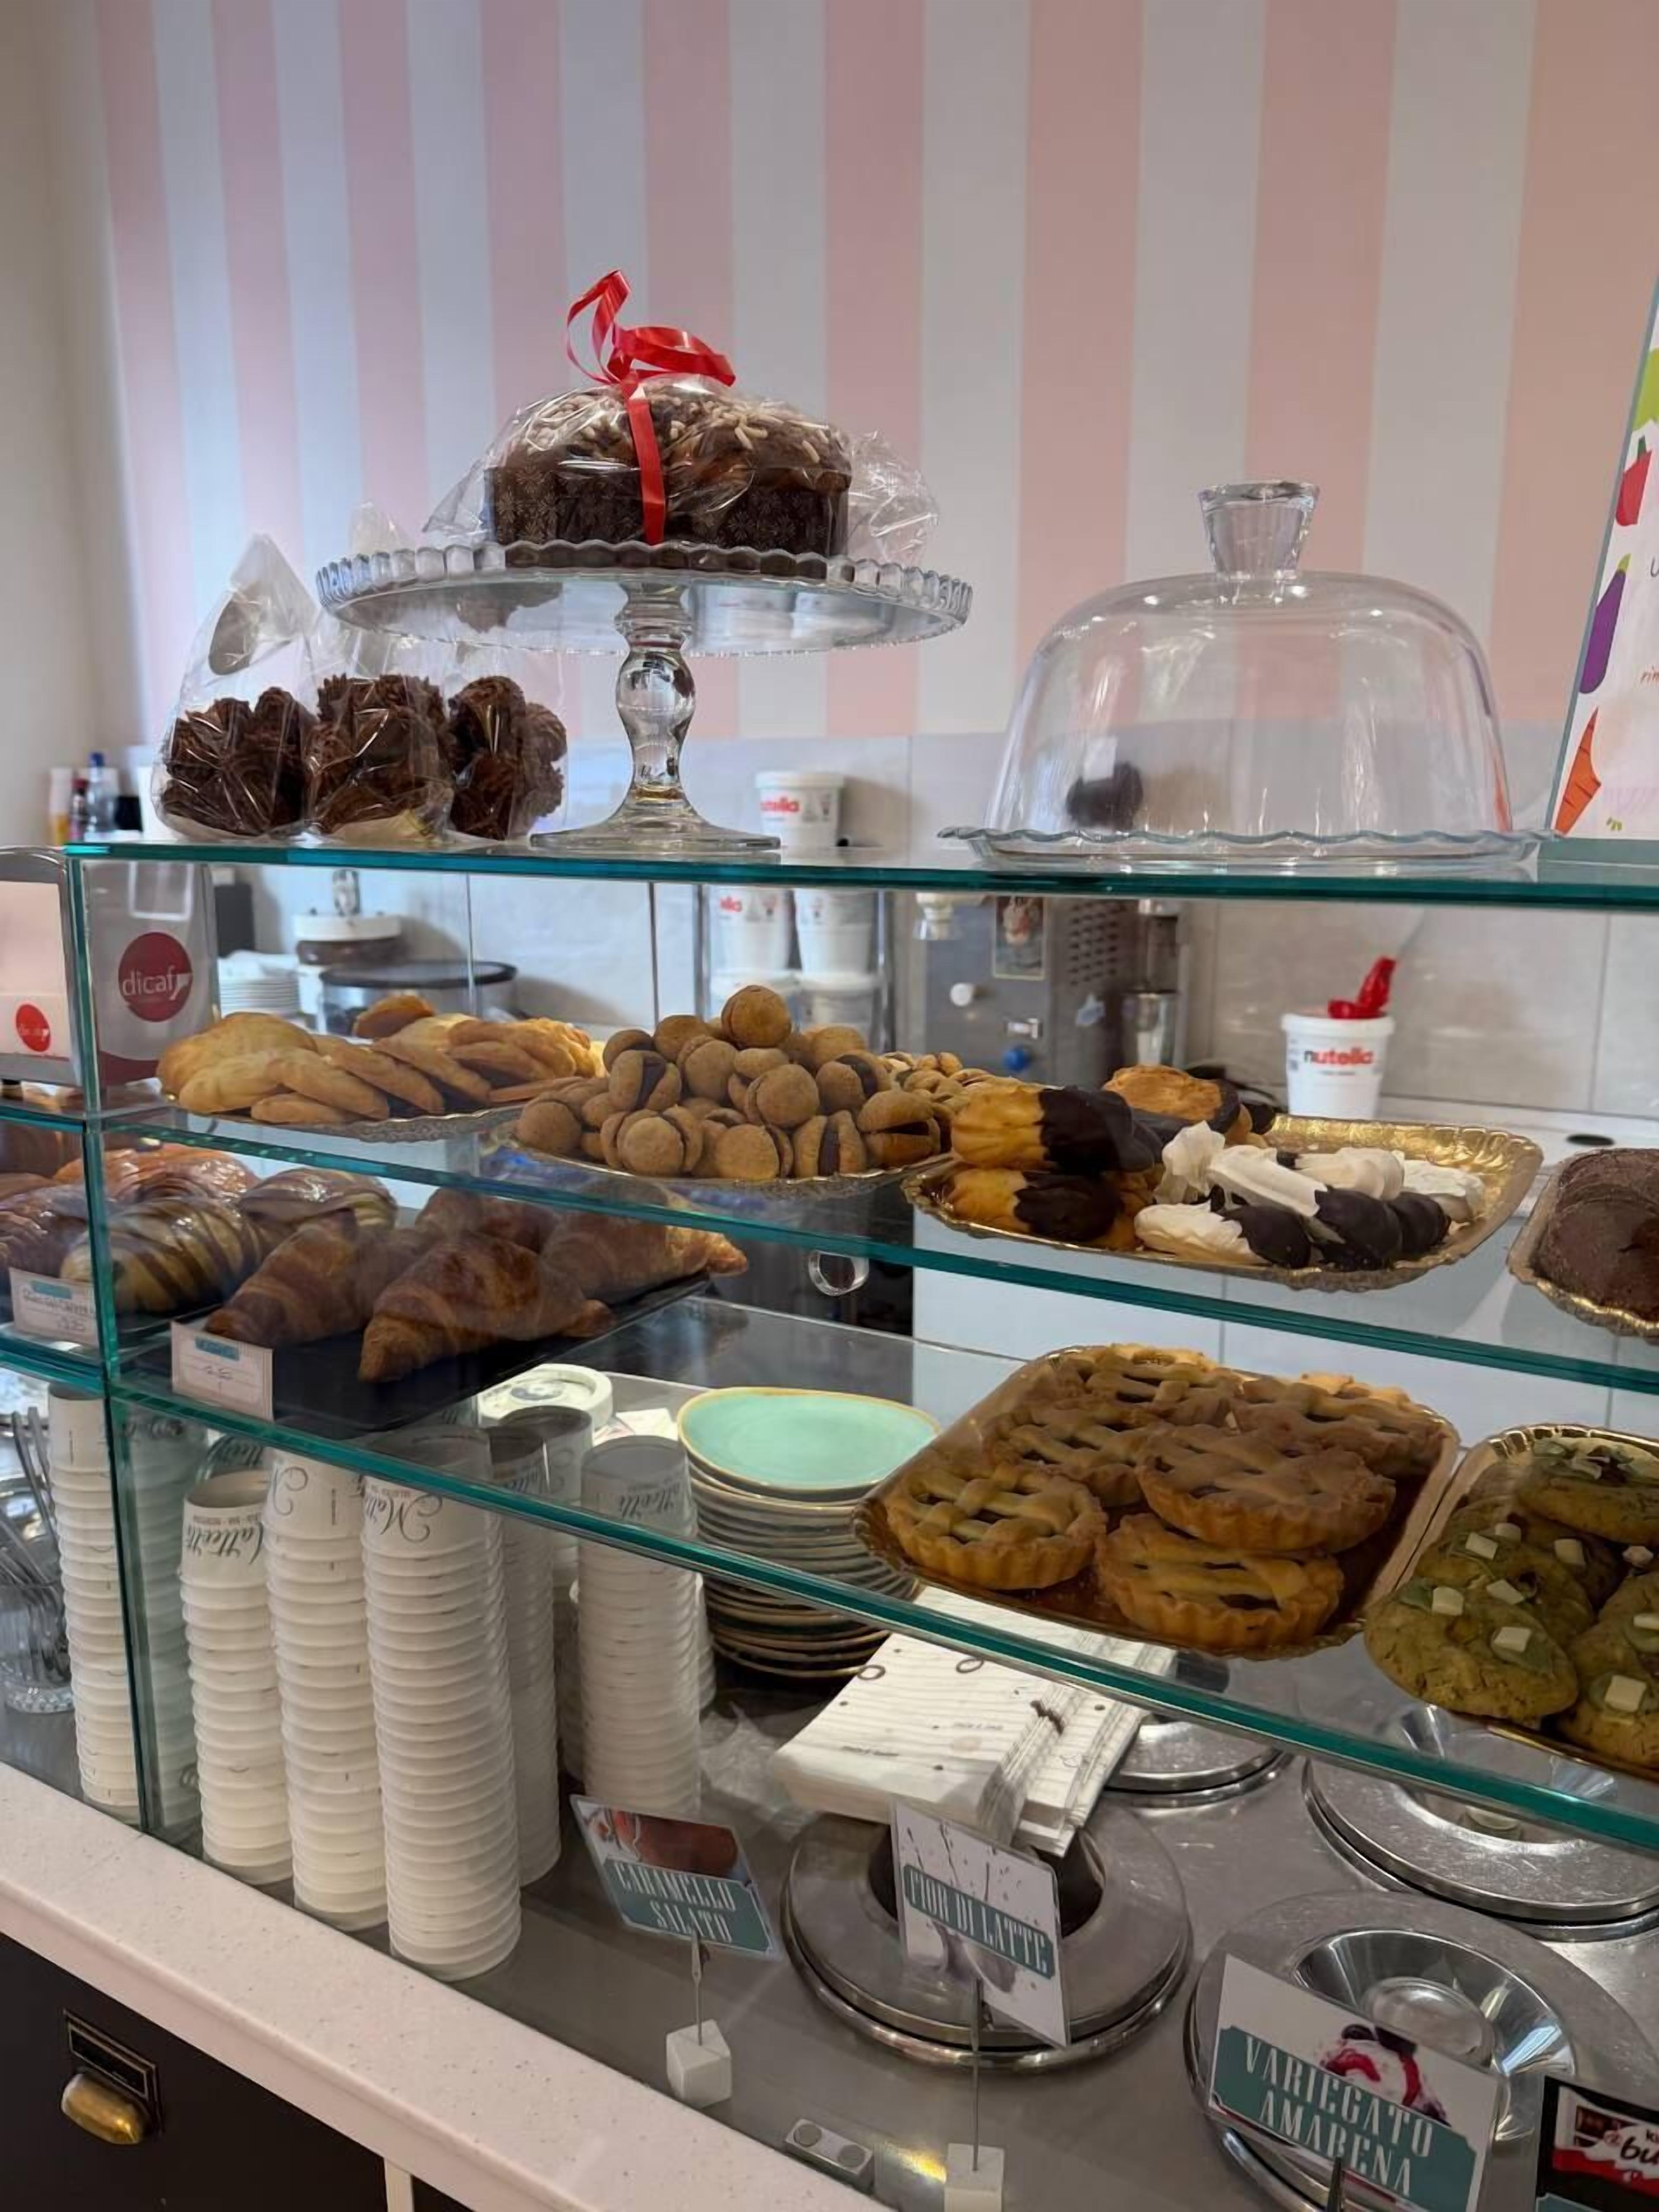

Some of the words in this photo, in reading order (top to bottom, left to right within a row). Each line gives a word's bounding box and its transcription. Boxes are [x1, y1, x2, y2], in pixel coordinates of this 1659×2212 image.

[1304, 1046, 1374, 1065] nutella
[614, 1862, 736, 1911] CARAMELLO
[650, 1900, 733, 1943] SALATO
[910, 1869, 950, 1923] FIOR
[955, 1892, 975, 1936] DI
[981, 1904, 1048, 1974] LATTE
[1246, 2035, 1433, 2158] VARIEGATO
[1260, 2089, 1411, 2198] AMARENA
